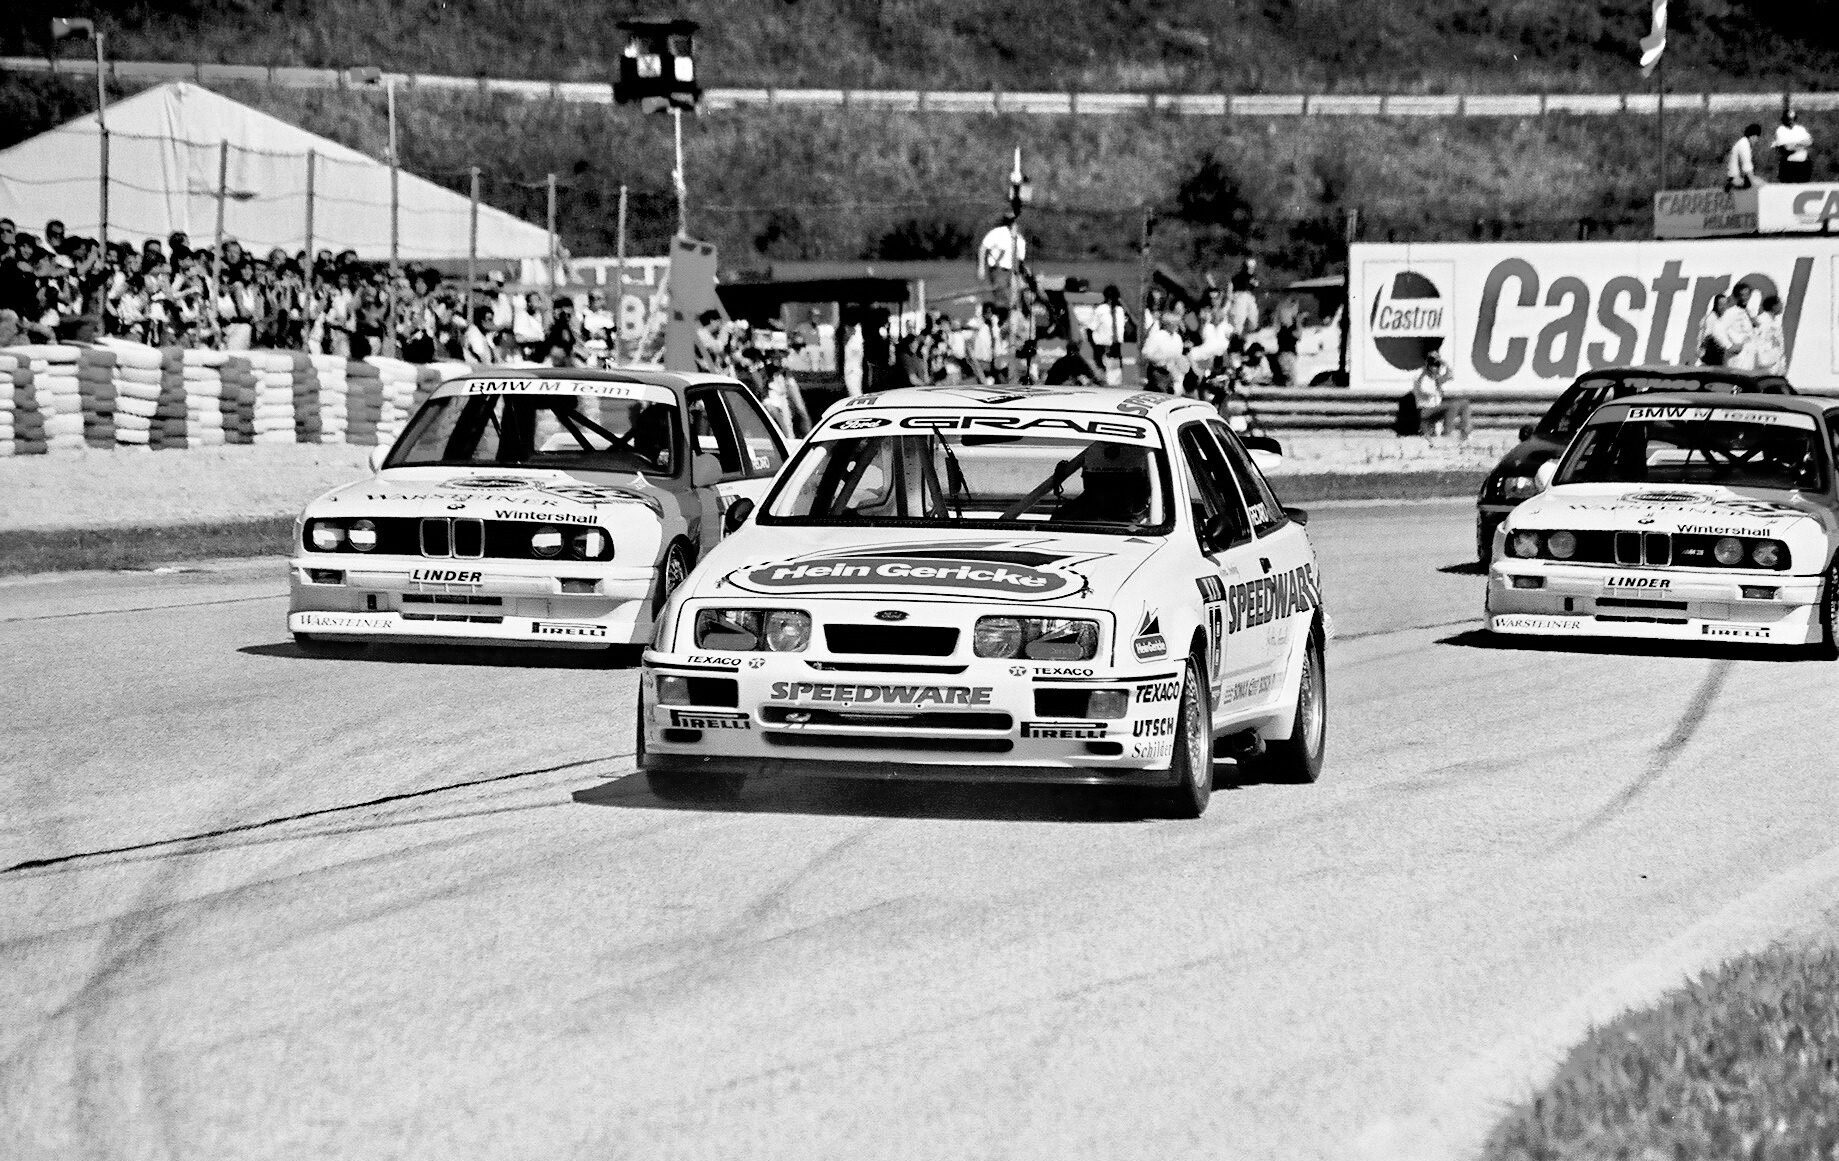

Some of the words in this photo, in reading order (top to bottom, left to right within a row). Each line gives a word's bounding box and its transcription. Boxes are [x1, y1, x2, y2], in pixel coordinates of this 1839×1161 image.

[1379, 304, 1445, 331] Castrol
[469, 381, 532, 393] BMW
[540, 382, 563, 394] M
[572, 383, 631, 397] Team
[1629, 408, 1688, 419] BMW
[840, 417, 881, 431] Ford
[900, 416, 1147, 439] GRAB
[495, 509, 599, 526] Wintershall
[1676, 524, 1771, 537] Wintershall
[412, 569, 482, 583] LINDER
[771, 562, 872, 580] Hein
[876, 563, 1047, 588] Gericke
[1607, 577, 1671, 589] LINDER
[300, 614, 393, 629] WARSTEINER
[531, 621, 606, 637] PIRELLI
[1495, 618, 1580, 630] WARSTEINER
[1702, 624, 1770, 638] PIRELLI
[687, 655, 742, 666] TEXACO
[1033, 667, 1094, 677] TEXACO
[770, 681, 993, 704] SPEEDWARE
[1135, 680, 1180, 704] TEXACO
[670, 709, 750, 730] PIRELLI
[1132, 717, 1174, 738] UTSCH
[1020, 721, 1108, 738] PIRELLI
